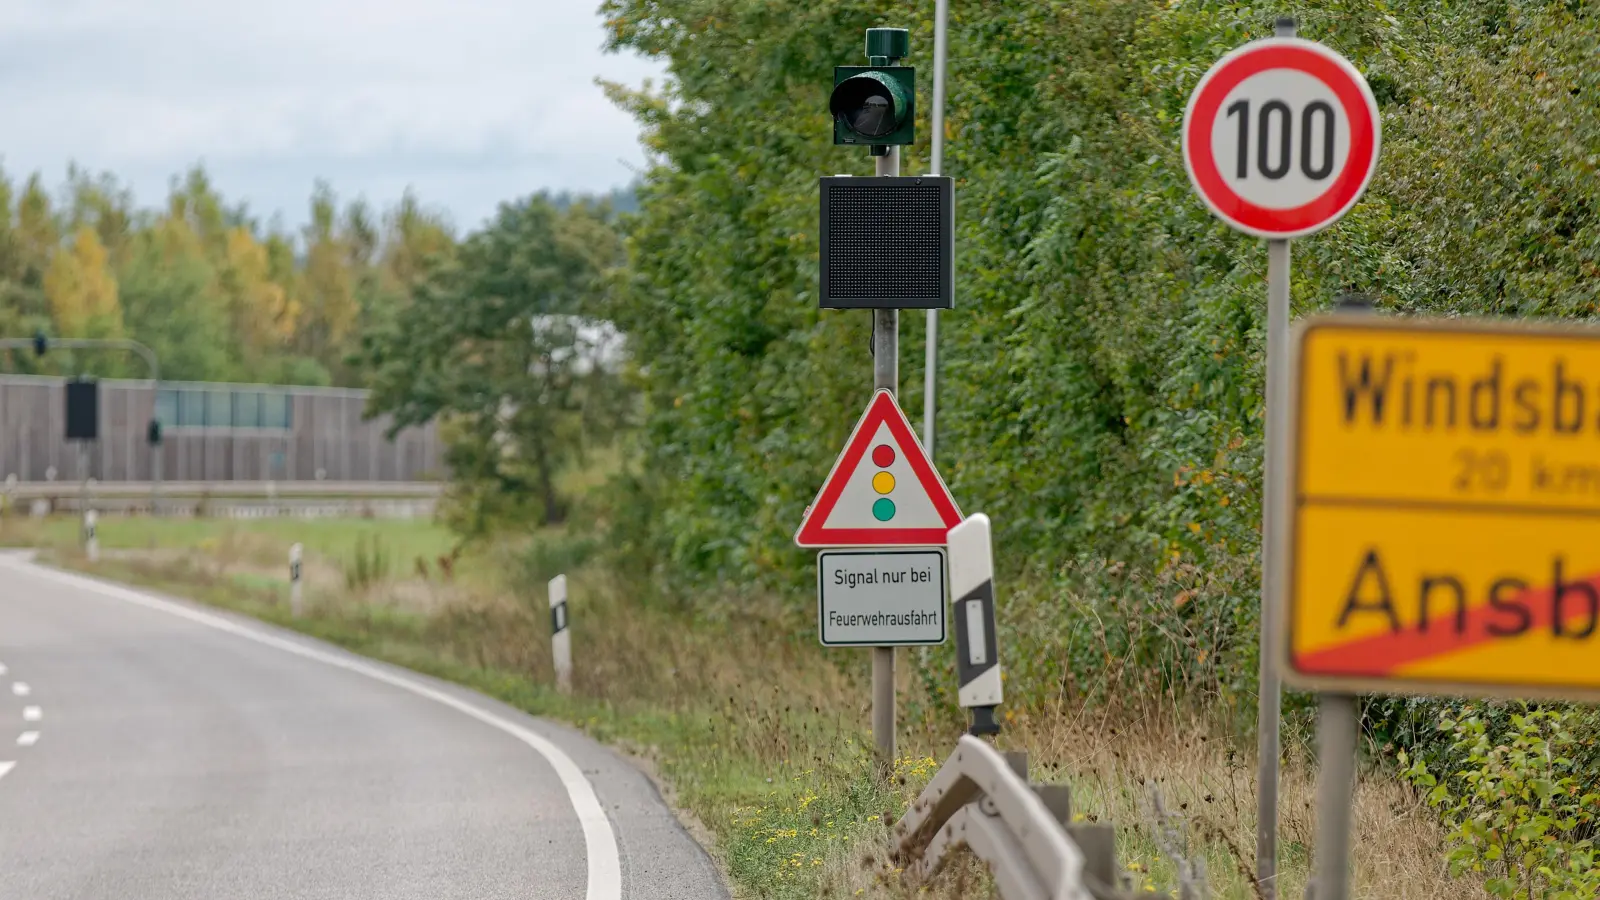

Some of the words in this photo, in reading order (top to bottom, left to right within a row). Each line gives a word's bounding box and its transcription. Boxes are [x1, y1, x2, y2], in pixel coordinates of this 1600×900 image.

[1226, 100, 1335, 181] 100
[1336, 349, 1600, 435] Windsb
[1452, 449, 1509, 492] 20
[834, 568, 879, 588] Signal
[882, 570, 906, 583] nur
[910, 566, 931, 583] bei
[829, 610, 937, 627] Feuerwehrausfahrt
